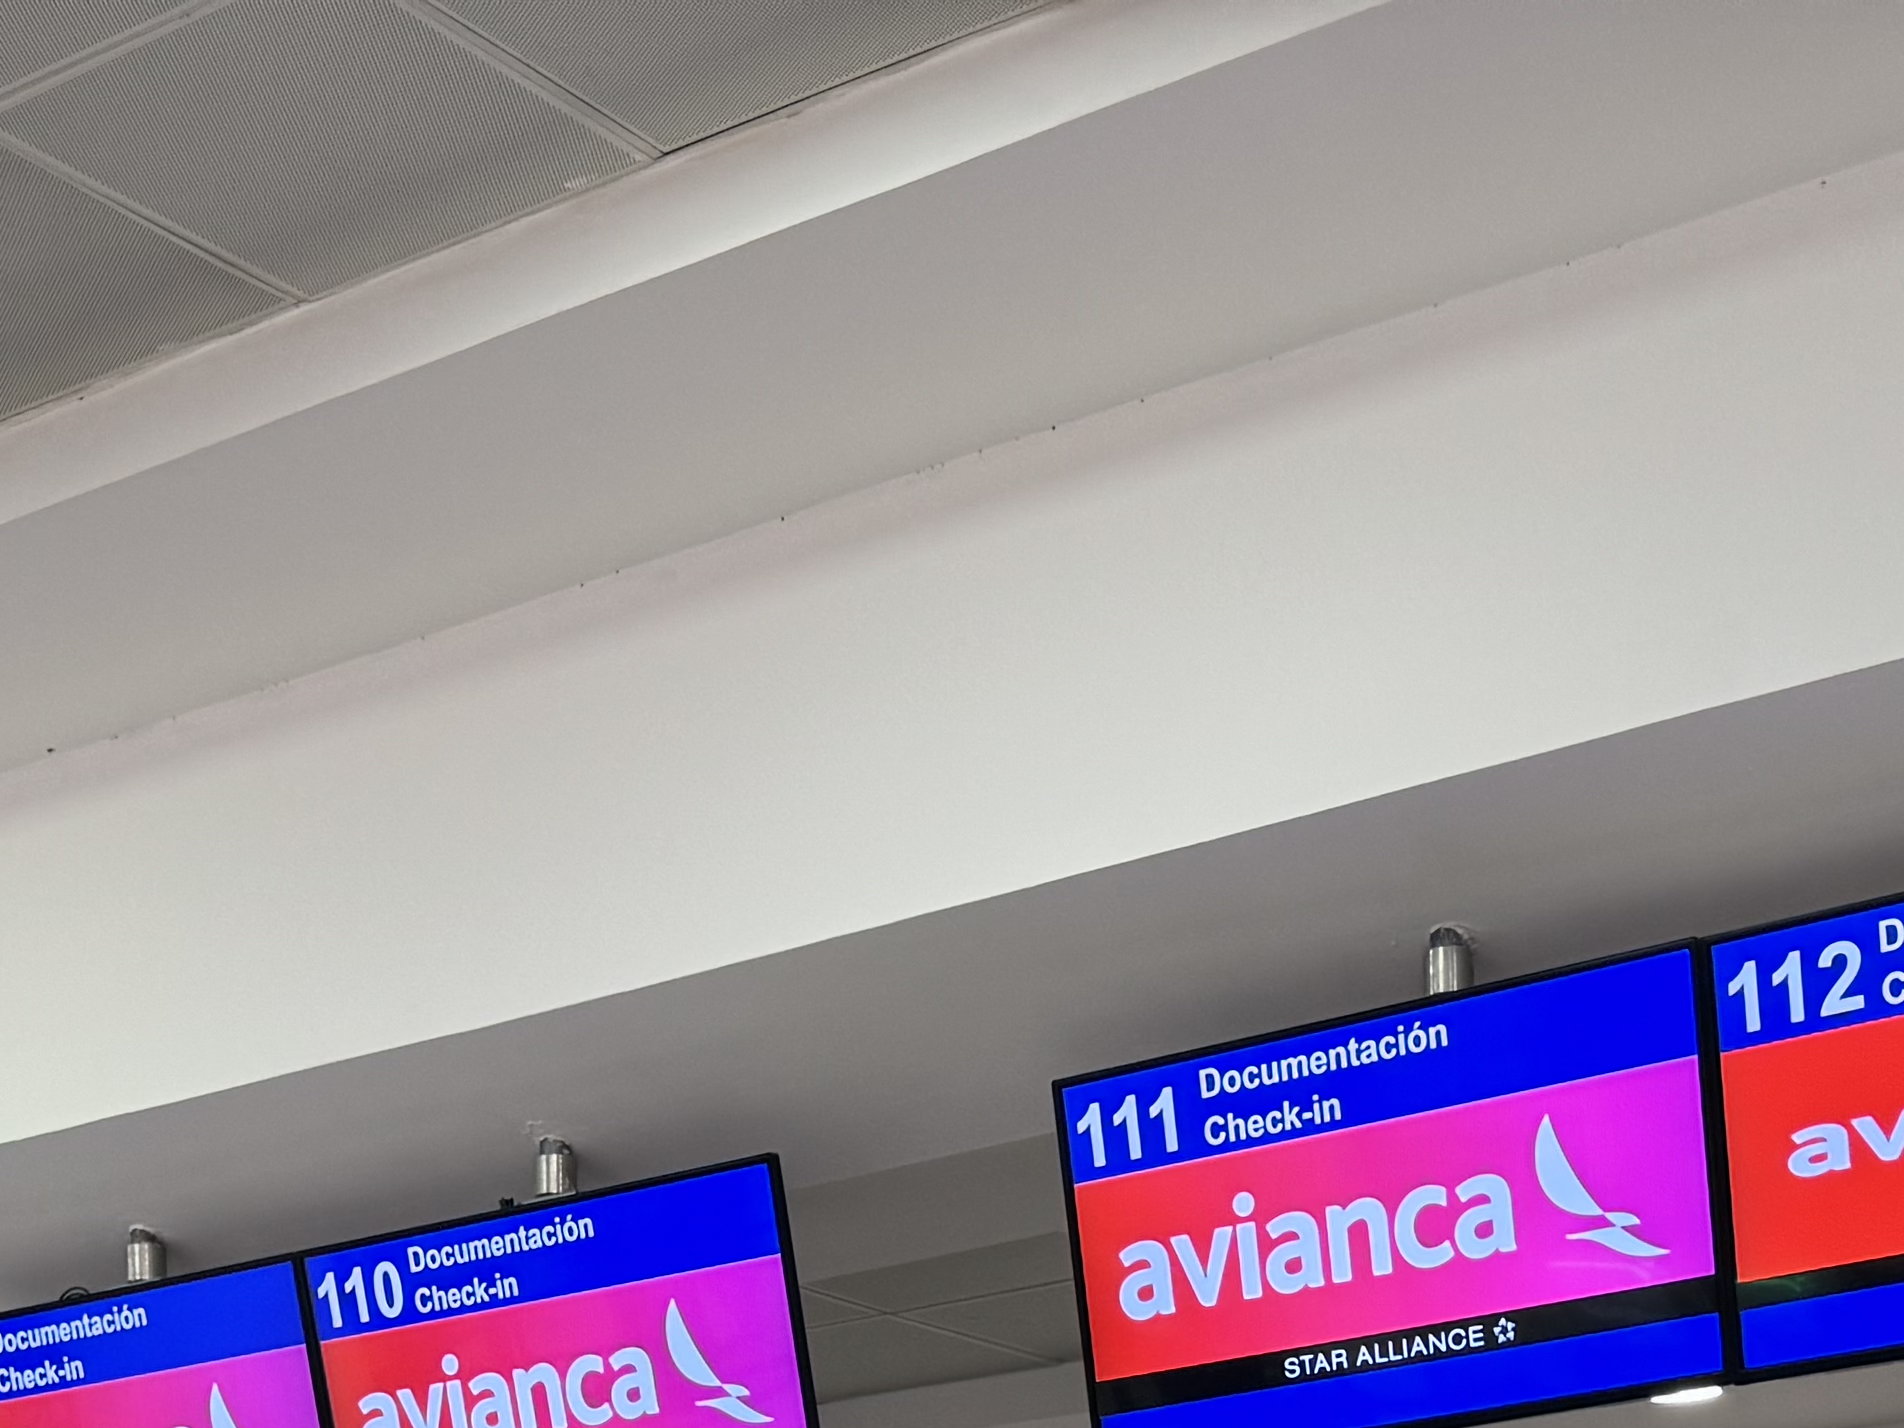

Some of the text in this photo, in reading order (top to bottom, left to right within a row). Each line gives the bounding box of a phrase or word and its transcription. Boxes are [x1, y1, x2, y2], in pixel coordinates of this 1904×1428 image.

[1727, 940, 1866, 1033] 112
[1198, 1018, 1448, 1100] Documentación
[1076, 1086, 1179, 1169] 111
[1203, 1092, 1342, 1147] Check-in
[407, 1214, 595, 1273] Documentación
[1117, 1172, 1517, 1322] avianca
[317, 1260, 404, 1329] 110
[414, 1272, 519, 1315] Check-in
[1283, 1324, 1485, 1379] STAR ALLIANCE
